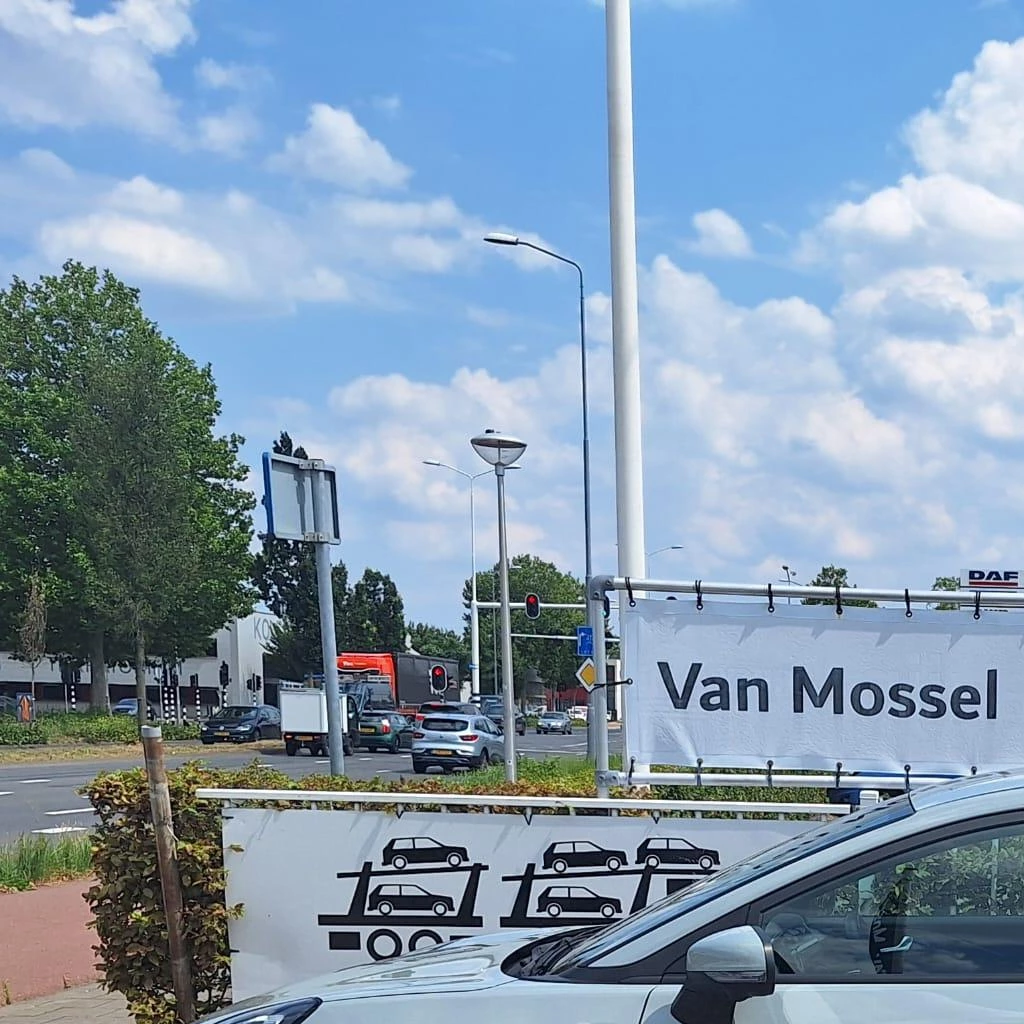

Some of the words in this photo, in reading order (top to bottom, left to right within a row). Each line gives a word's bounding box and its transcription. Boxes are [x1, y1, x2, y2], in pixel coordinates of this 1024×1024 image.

[968, 570, 1018, 581] DAF
[657, 661, 769, 712] Van
[793, 666, 997, 720] Mossel
